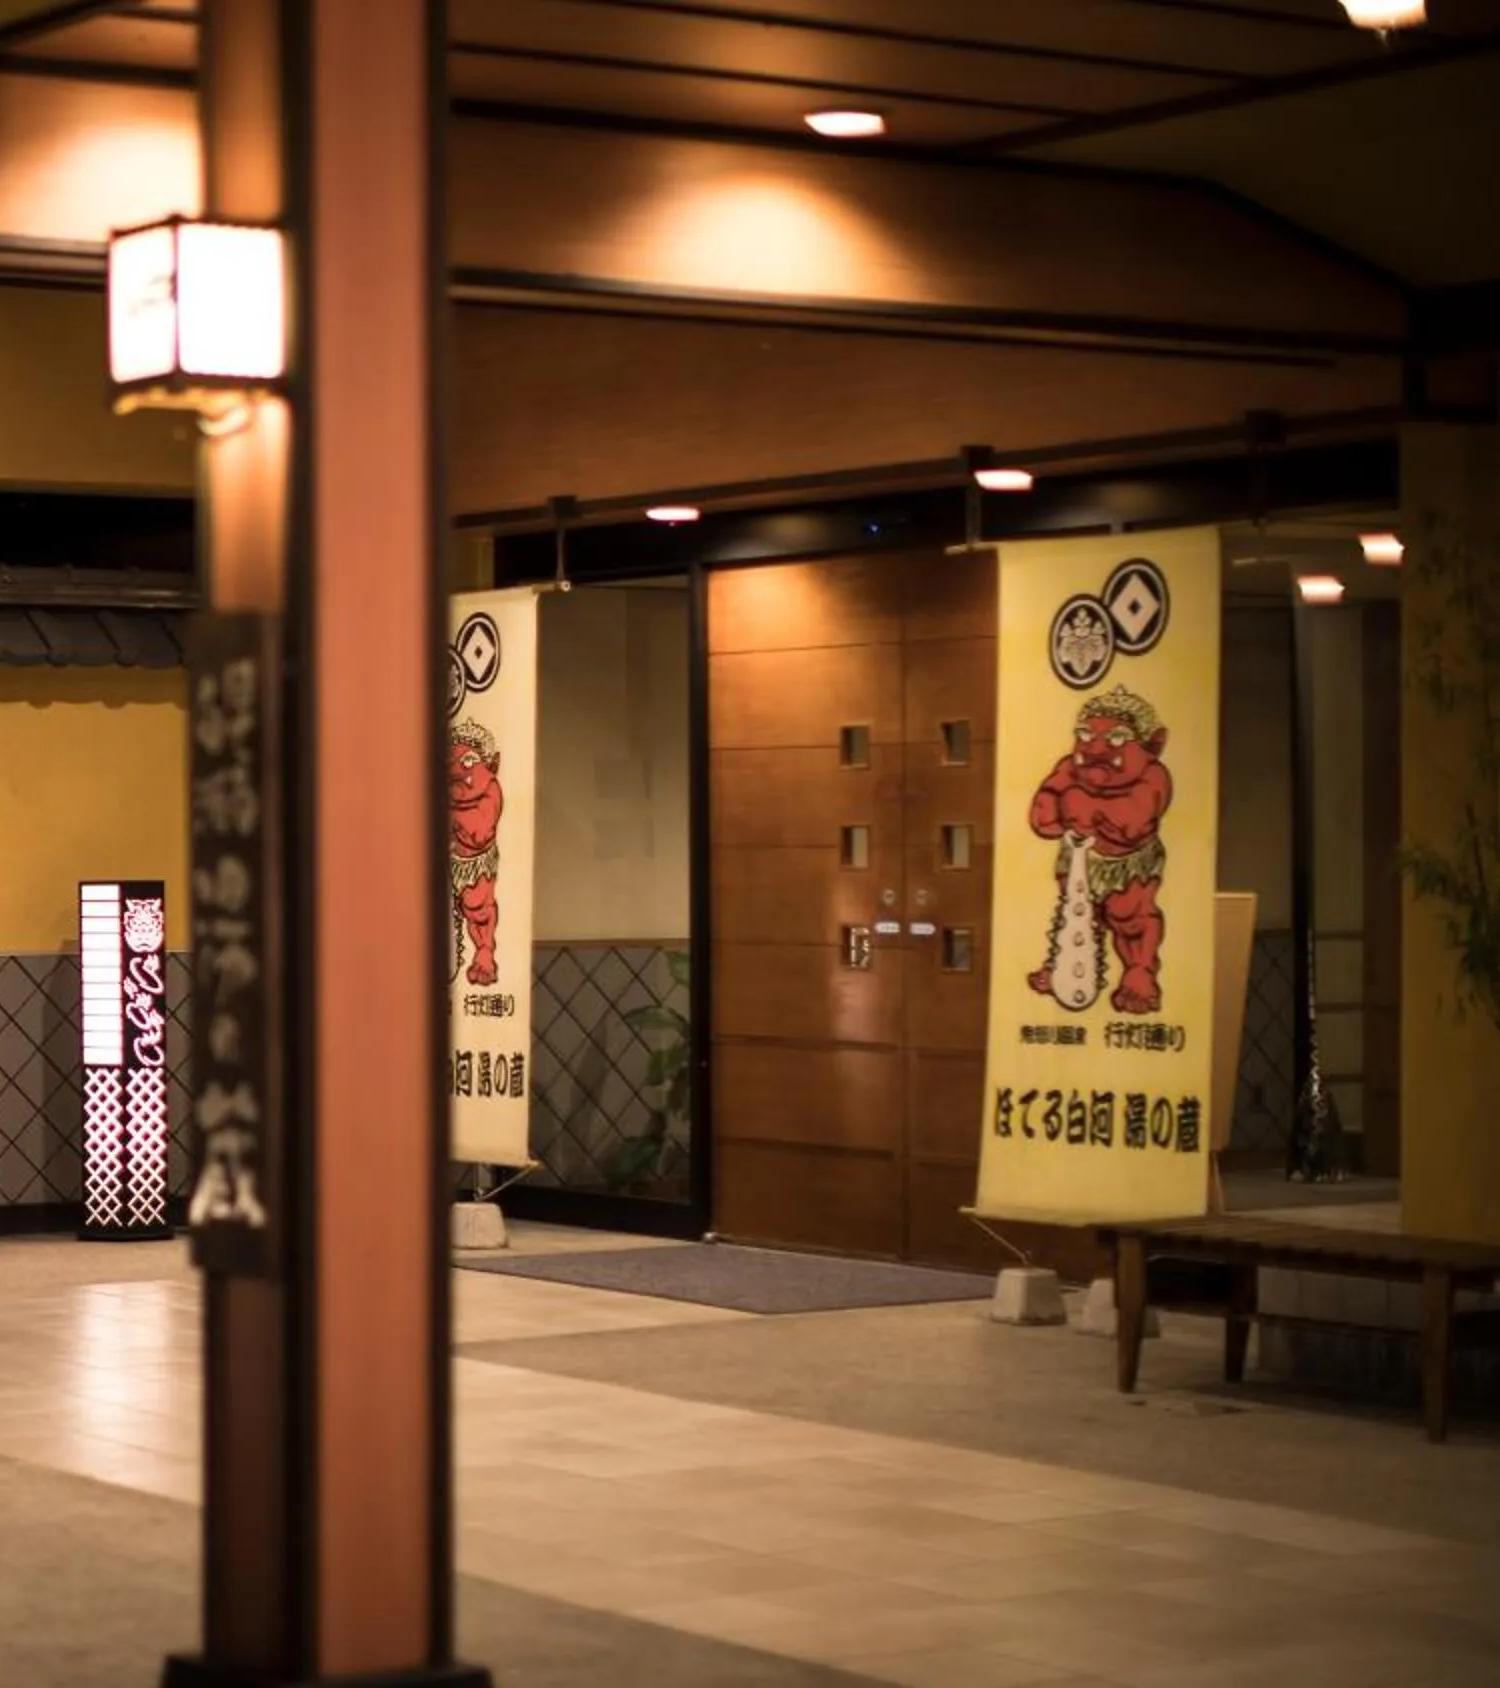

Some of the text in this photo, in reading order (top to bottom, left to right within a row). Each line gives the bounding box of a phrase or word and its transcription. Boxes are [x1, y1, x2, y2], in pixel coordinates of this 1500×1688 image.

[477, 1050, 524, 1098] 湯の蔵
[995, 1087, 1202, 1153] ほてる白河 湯の蔵
